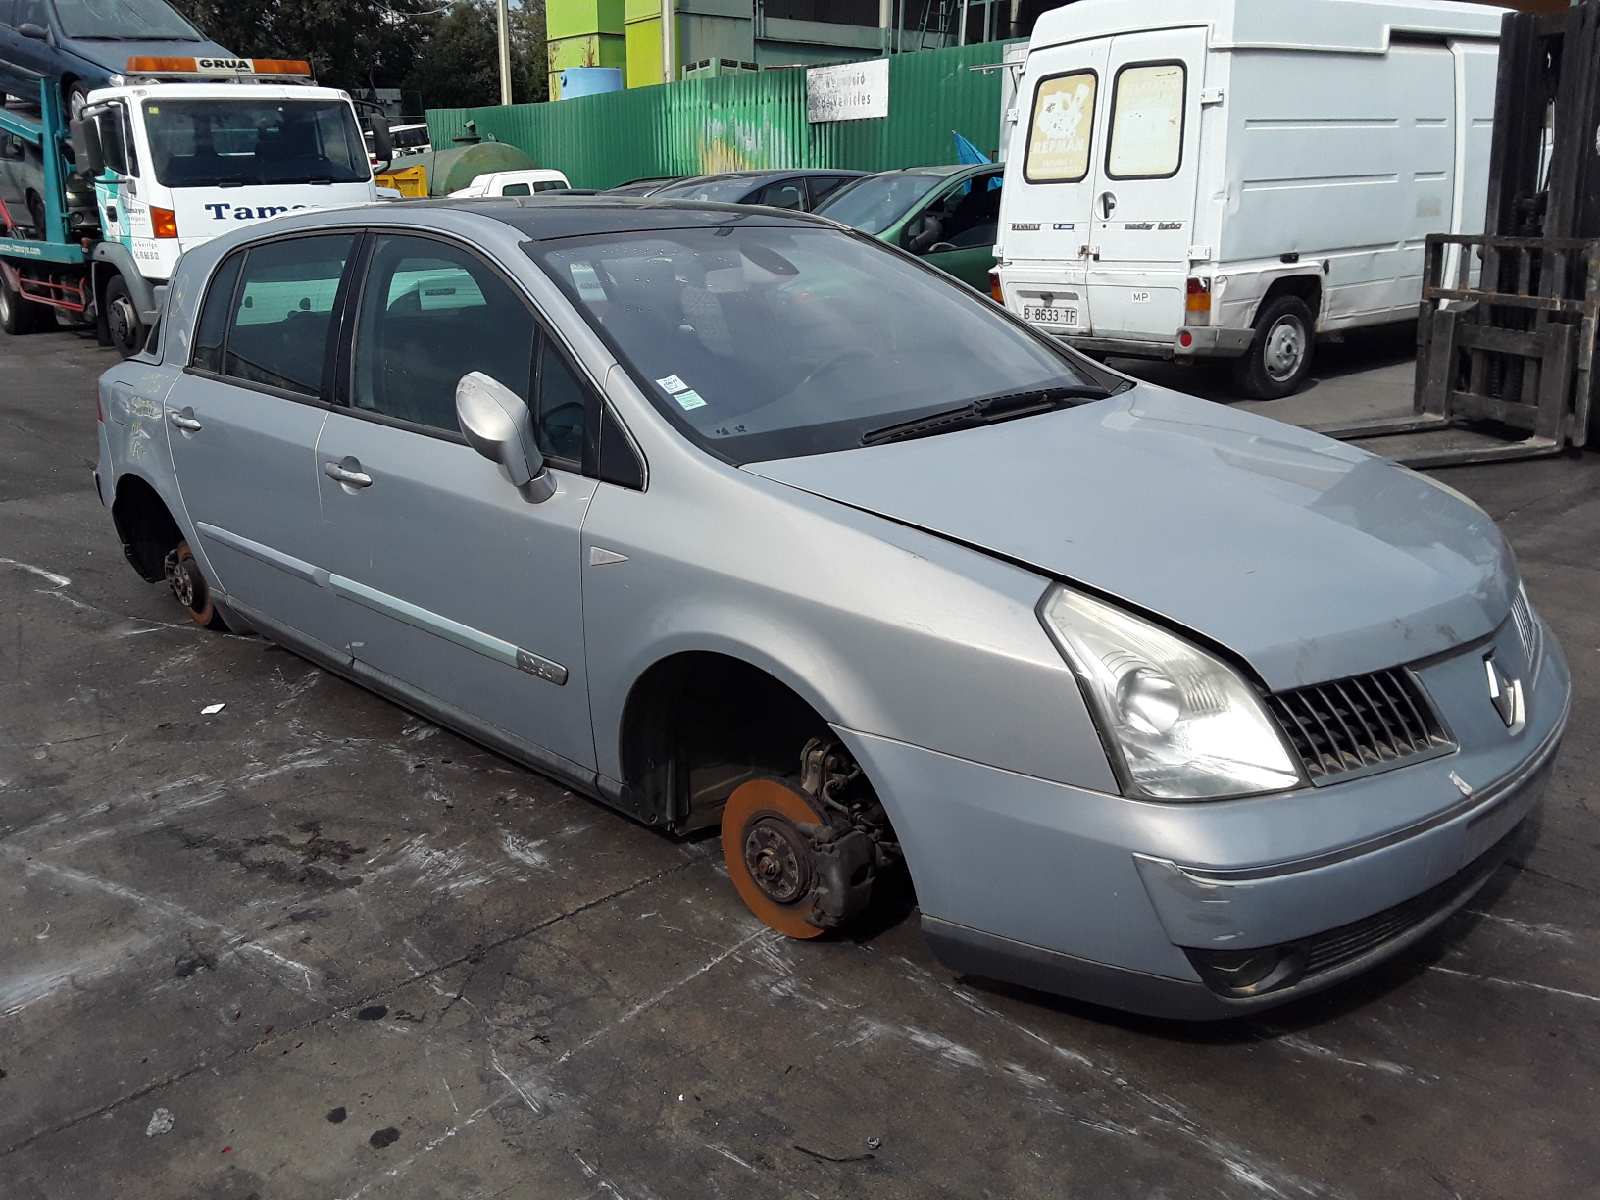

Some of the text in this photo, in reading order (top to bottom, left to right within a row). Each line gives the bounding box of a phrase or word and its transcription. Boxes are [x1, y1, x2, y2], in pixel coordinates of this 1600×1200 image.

[199, 59, 250, 69] GRUA
[833, 91, 871, 107] Veicles
[204, 202, 318, 220] Tam
[1133, 293, 1149, 301] MP
